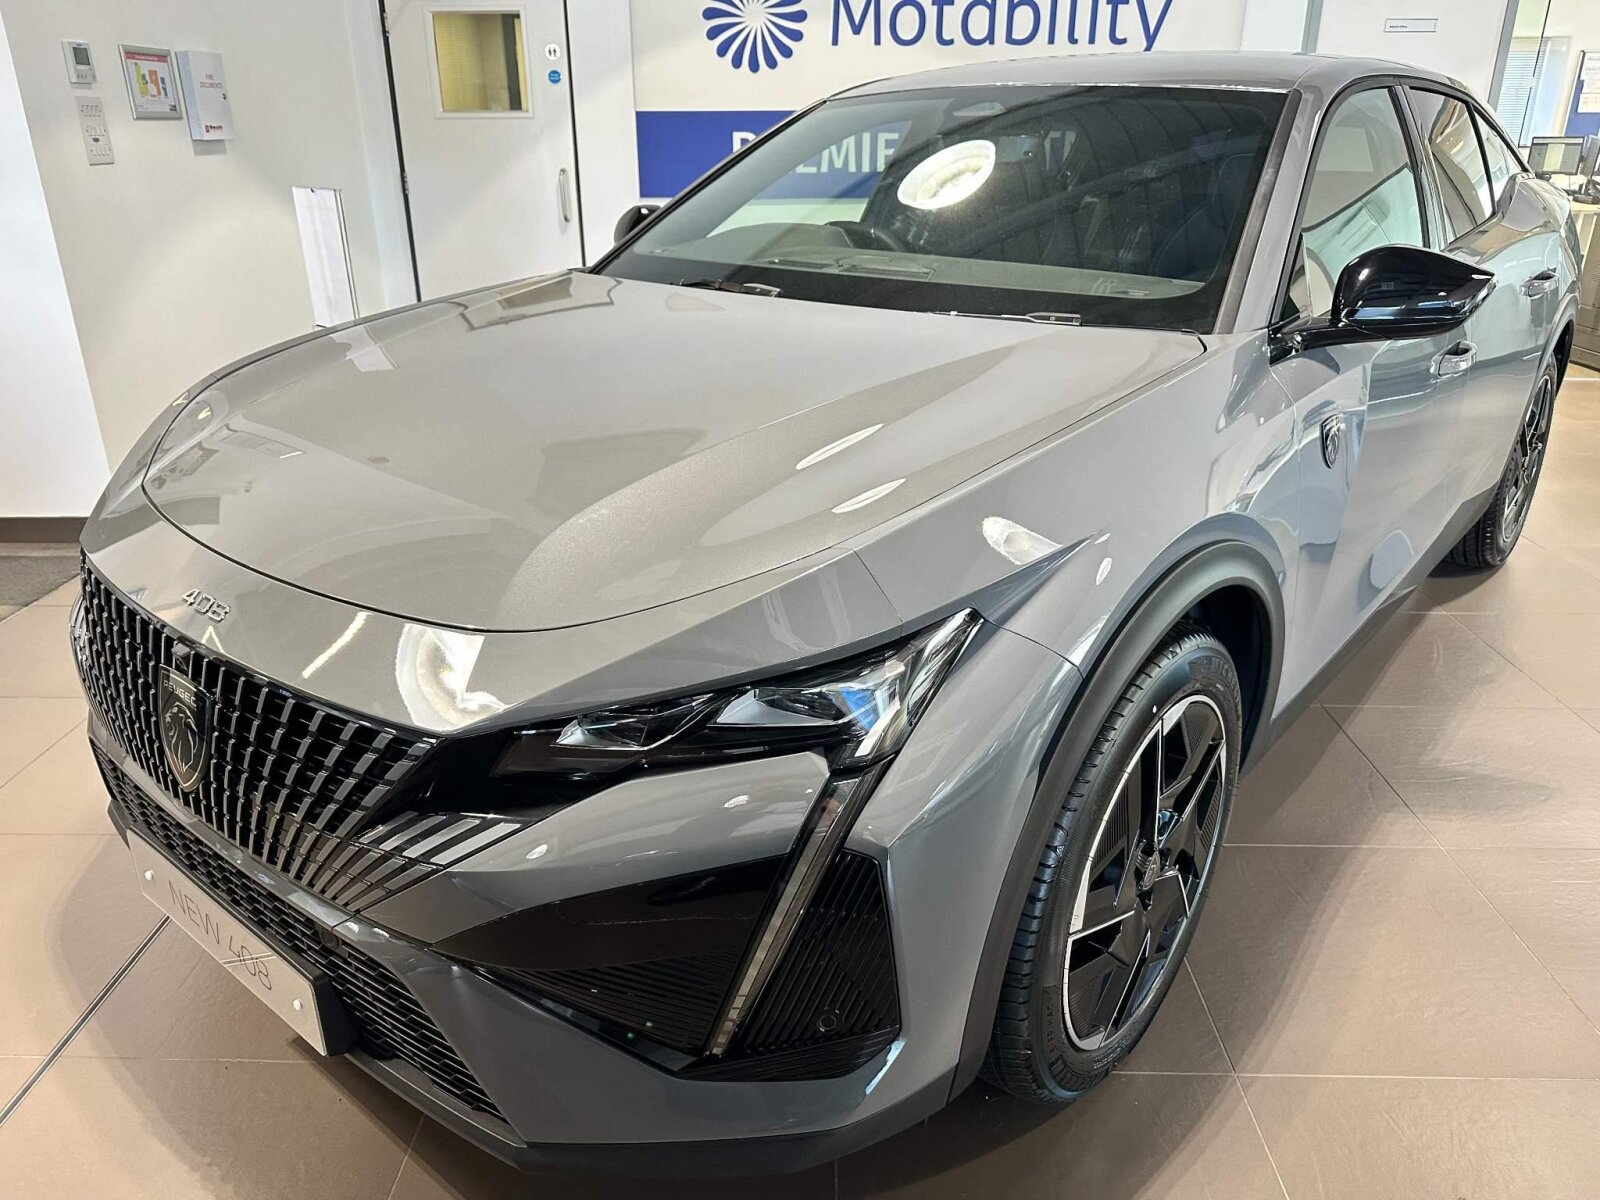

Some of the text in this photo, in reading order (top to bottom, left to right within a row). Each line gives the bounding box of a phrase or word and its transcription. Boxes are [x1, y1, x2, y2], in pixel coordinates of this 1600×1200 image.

[831, 0, 1172, 51] Motability
[182, 588, 231, 624] 408
[163, 679, 199, 708] PEUGEO
[168, 879, 272, 991] NEW 408
